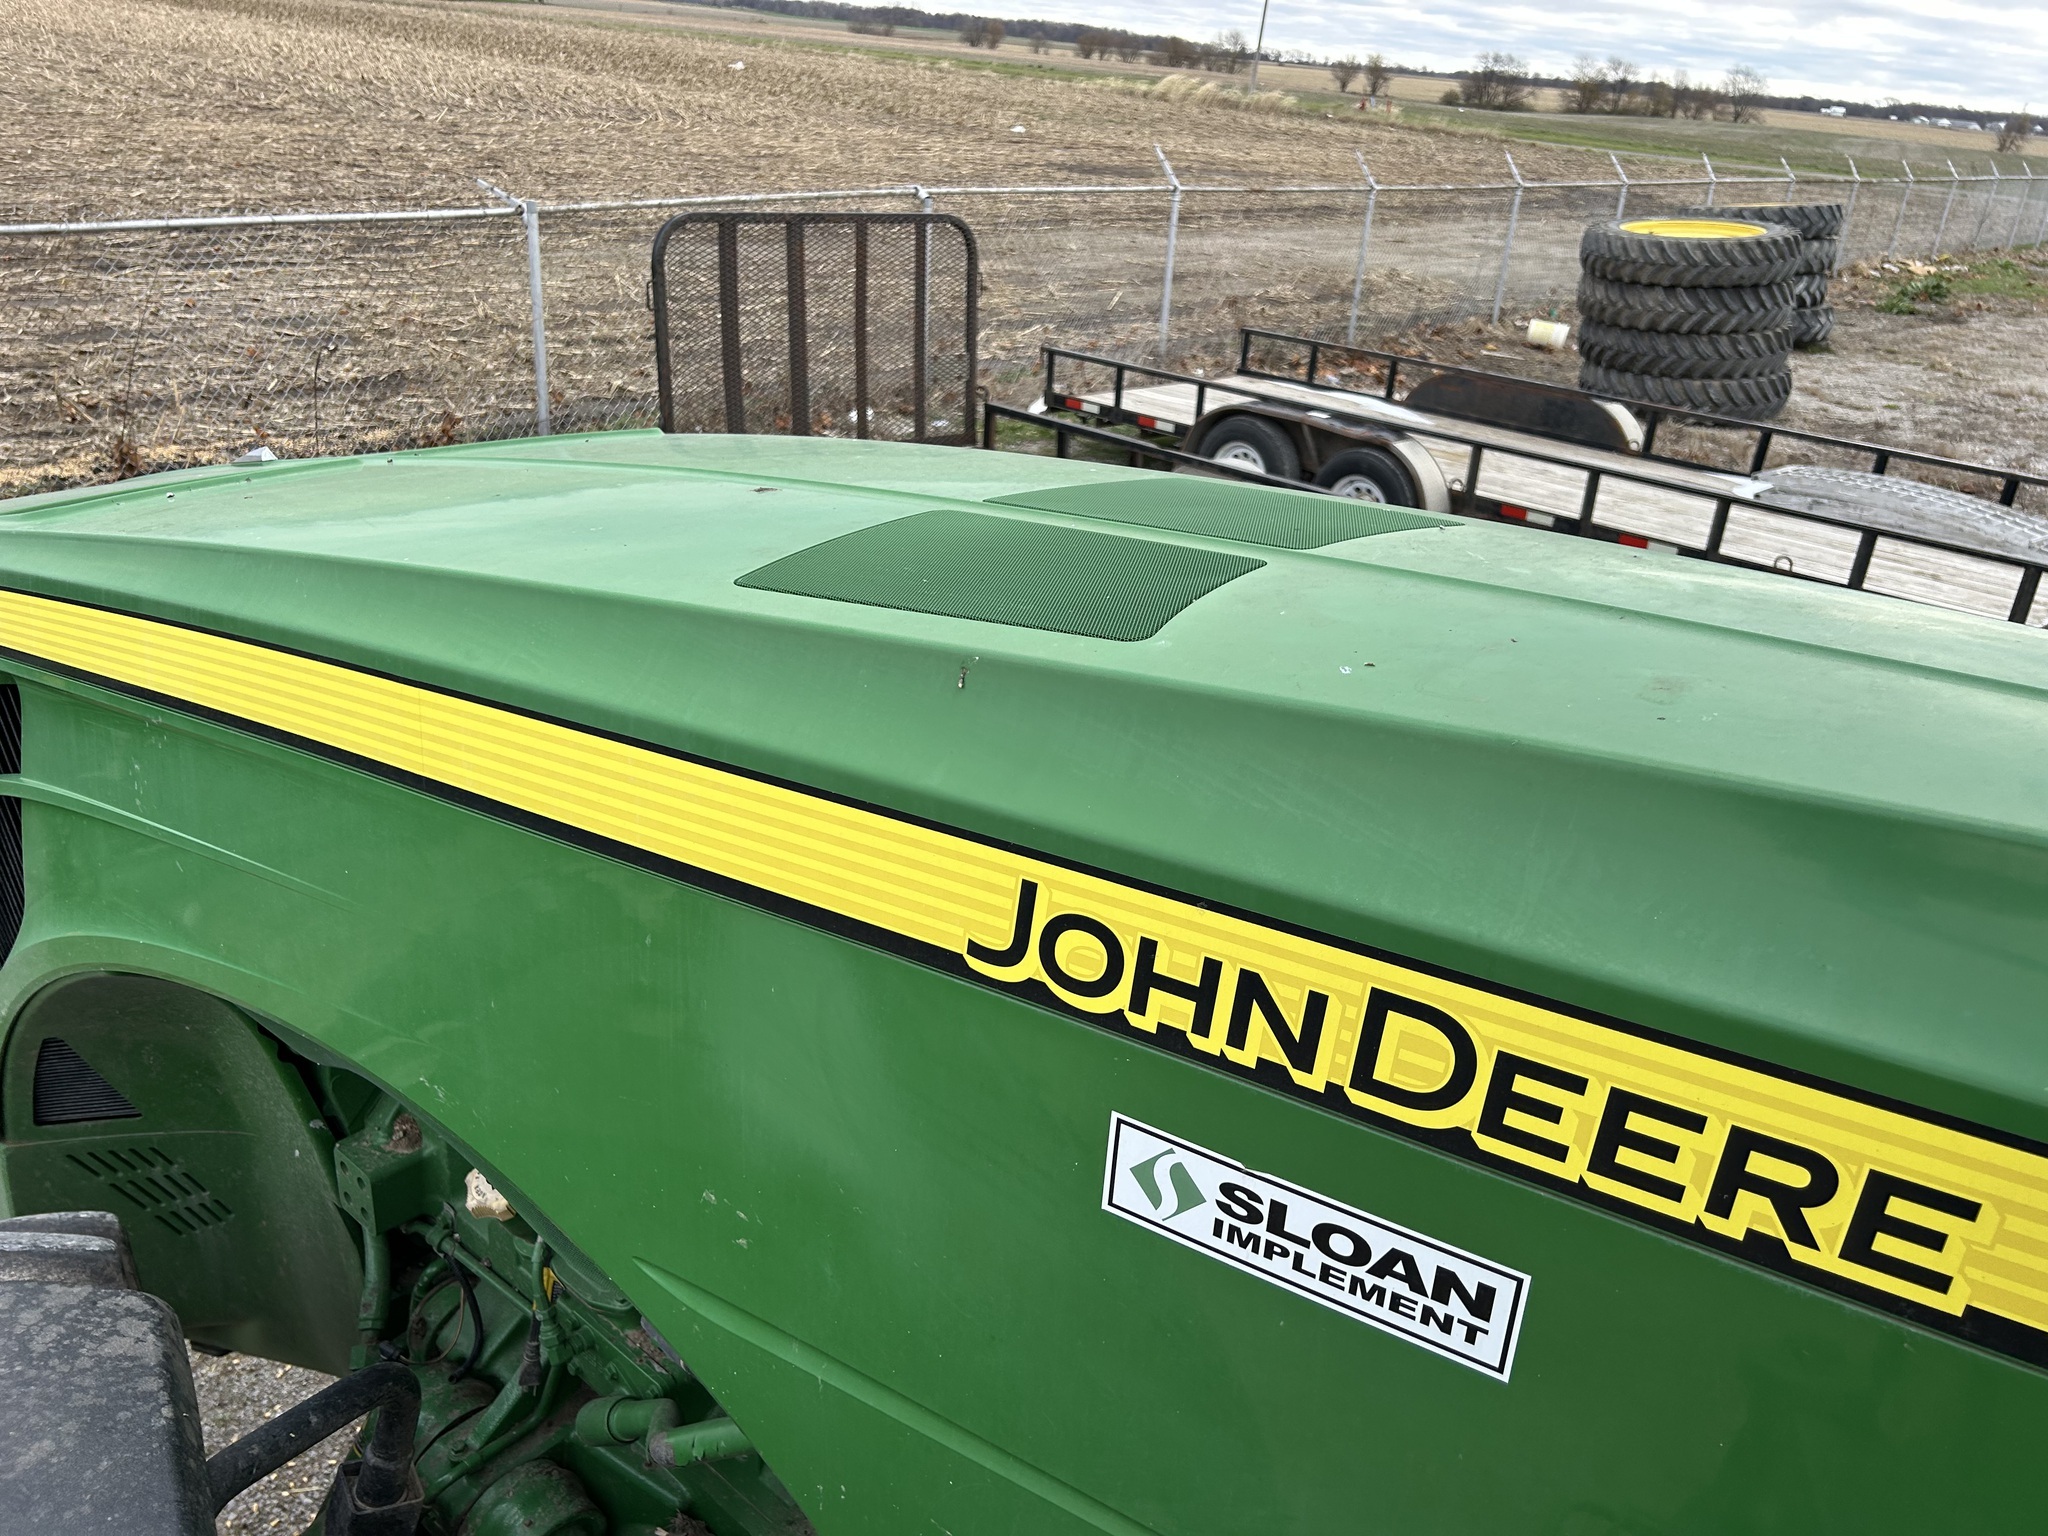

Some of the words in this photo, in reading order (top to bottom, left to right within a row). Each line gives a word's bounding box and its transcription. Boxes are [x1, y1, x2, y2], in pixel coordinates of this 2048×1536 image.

[967, 878, 1329, 1076] JOHN
[1349, 986, 1982, 1295] DEERE
[1212, 1217, 1490, 1346] IMPLEMENT
[1214, 1181, 1497, 1323] SLOAN
